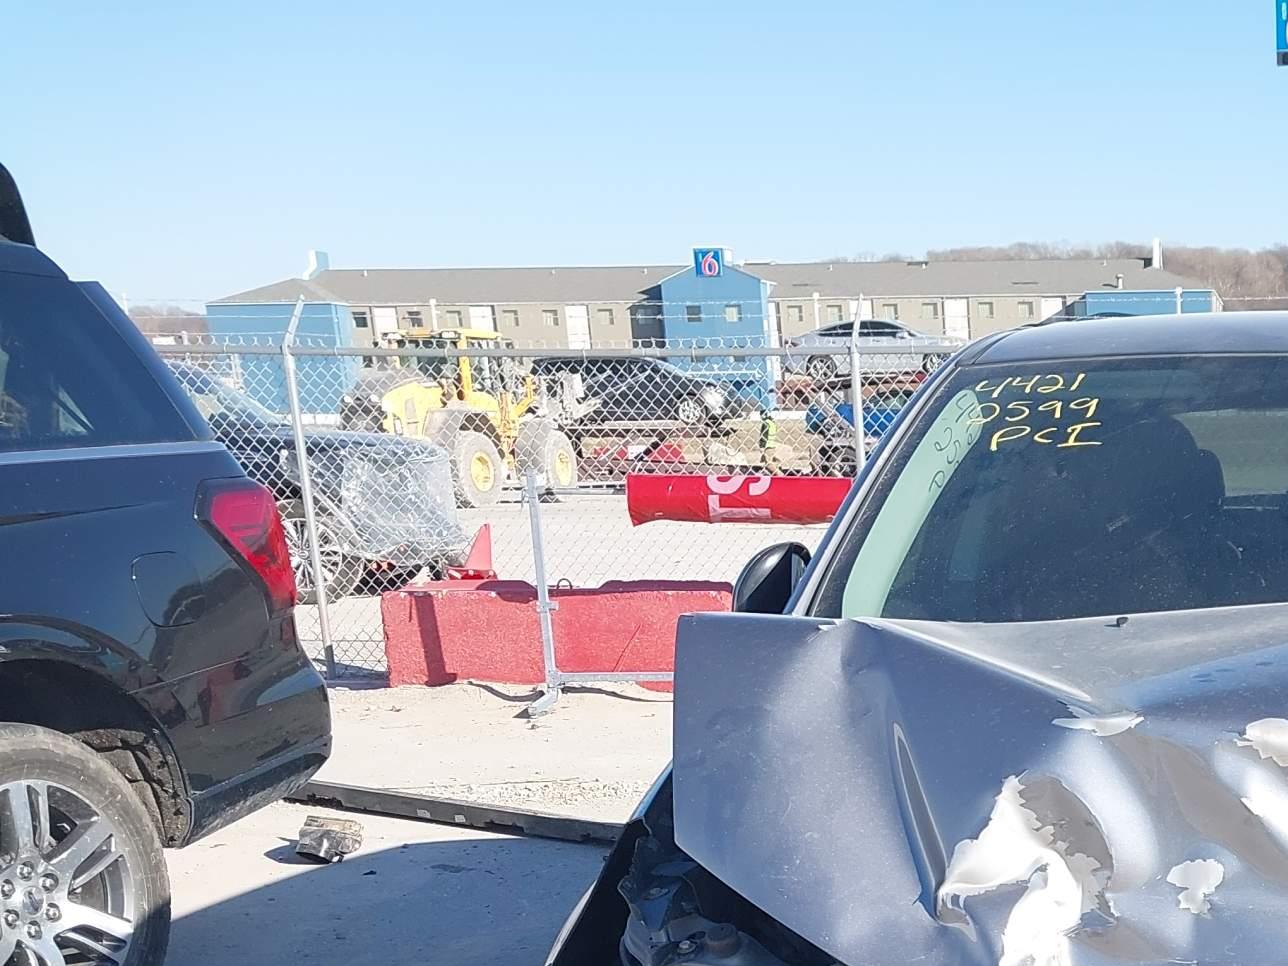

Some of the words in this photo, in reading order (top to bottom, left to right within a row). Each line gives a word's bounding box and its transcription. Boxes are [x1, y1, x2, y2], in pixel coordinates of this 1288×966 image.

[702, 251, 719, 276] 6
[975, 373, 1087, 398] 4421
[966, 397, 1100, 425] 2599
[990, 421, 1103, 452] PCI
